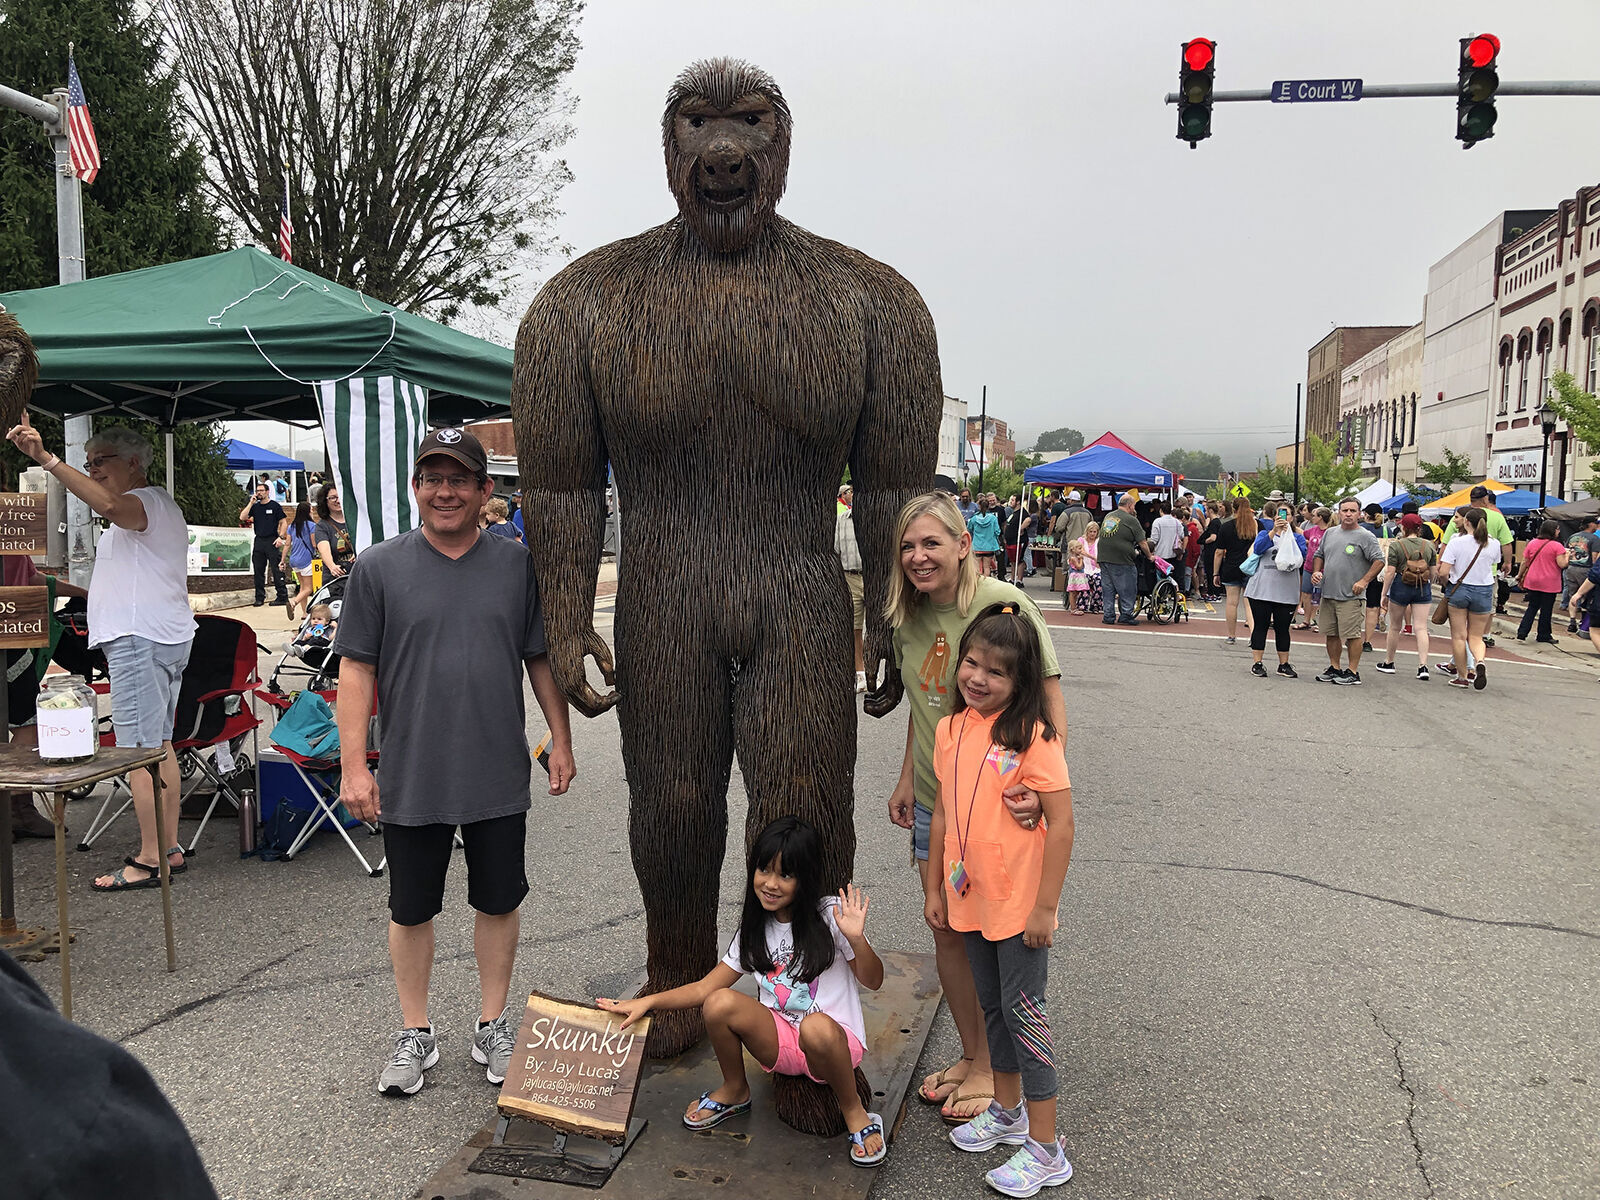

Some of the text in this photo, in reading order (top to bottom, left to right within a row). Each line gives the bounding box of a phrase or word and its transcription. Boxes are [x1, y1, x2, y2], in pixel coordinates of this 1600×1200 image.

[1281, 80, 1356, 99] E Court W
[1499, 463, 1537, 479] BAIL BONDS
[3, 494, 35, 507] with
[8, 508, 36, 520] free
[526, 1015, 635, 1068] Skunky
[524, 1055, 621, 1080] By: Jay Lucas
[520, 1074, 614, 1096] jaylucas@jaylucas.net
[531, 1093, 596, 1110] 864-425-5506
